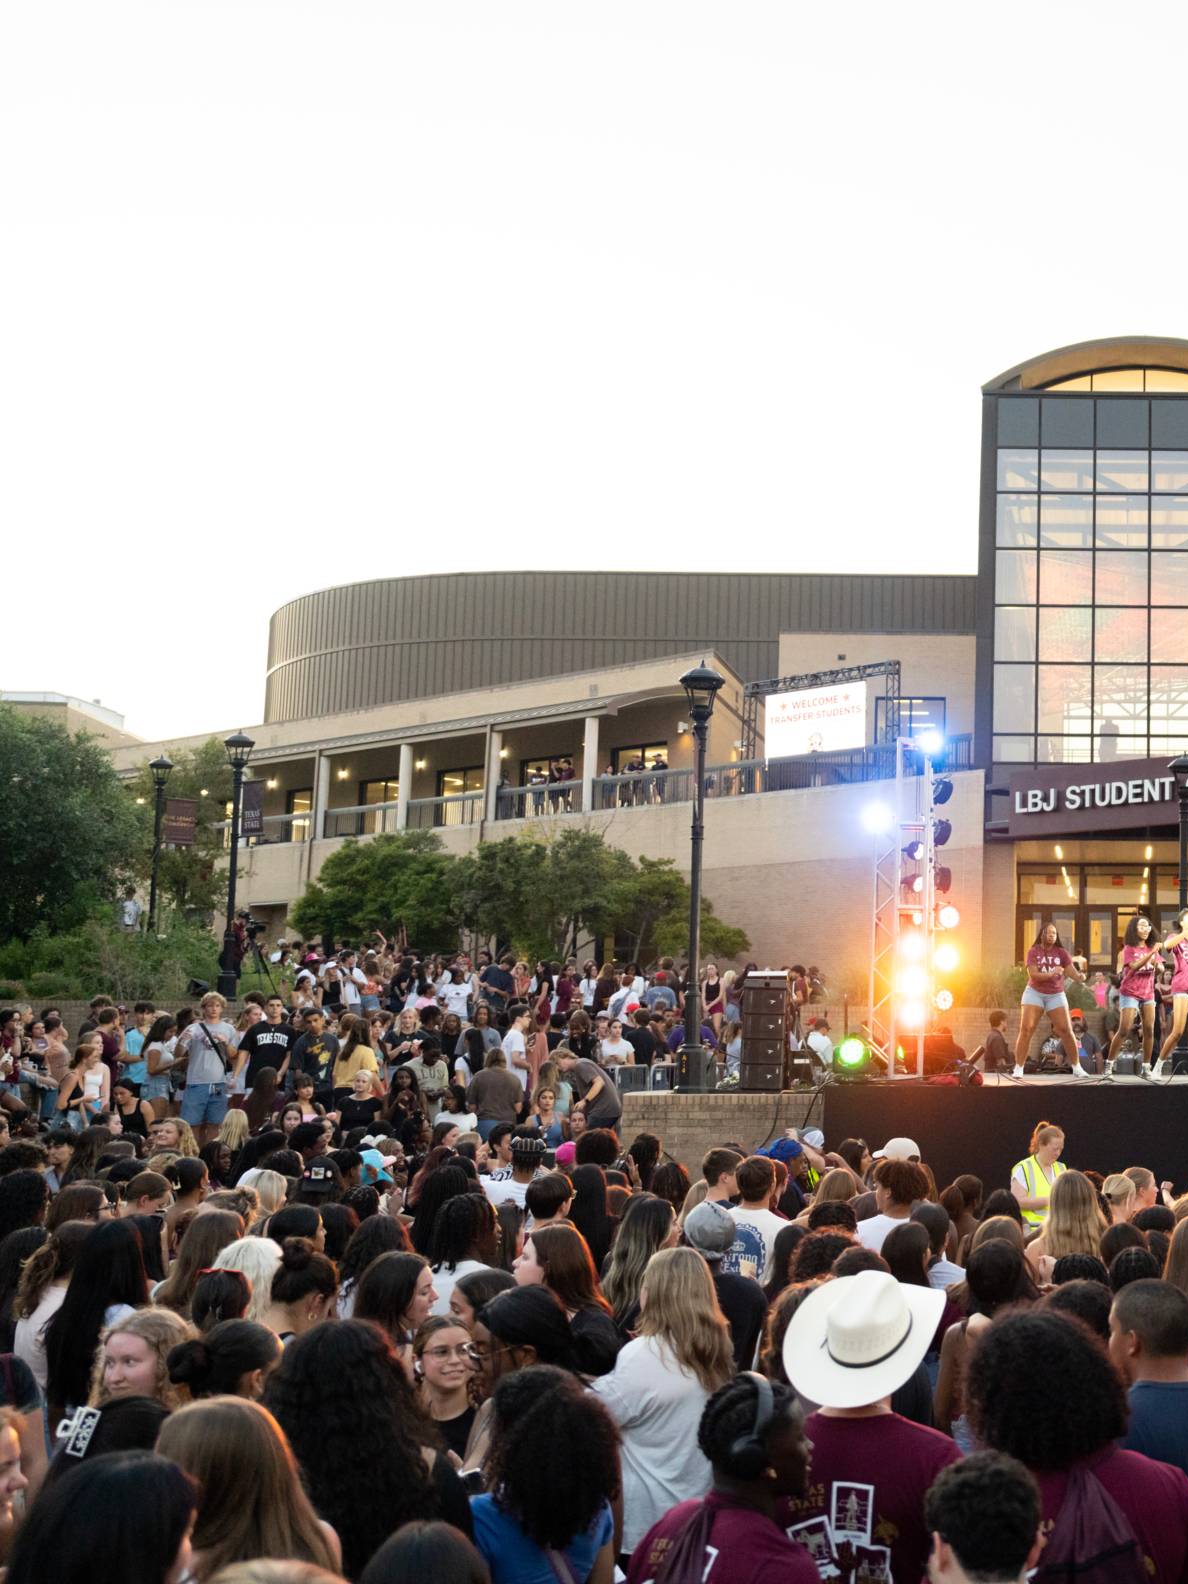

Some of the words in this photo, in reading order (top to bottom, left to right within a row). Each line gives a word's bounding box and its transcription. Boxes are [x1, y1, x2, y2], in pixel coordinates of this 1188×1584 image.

[791, 695, 839, 710] WELCOME
[770, 711, 813, 725] TRANSFER
[816, 705, 862, 719] STUDENTS
[1015, 788, 1055, 814] LBJ
[1065, 776, 1175, 810] STUDENT
[244, 809, 261, 818] TEXAS
[244, 820, 261, 829] STATE
[256, 1032, 273, 1046] TEXAS
[274, 1032, 289, 1047] STATE
